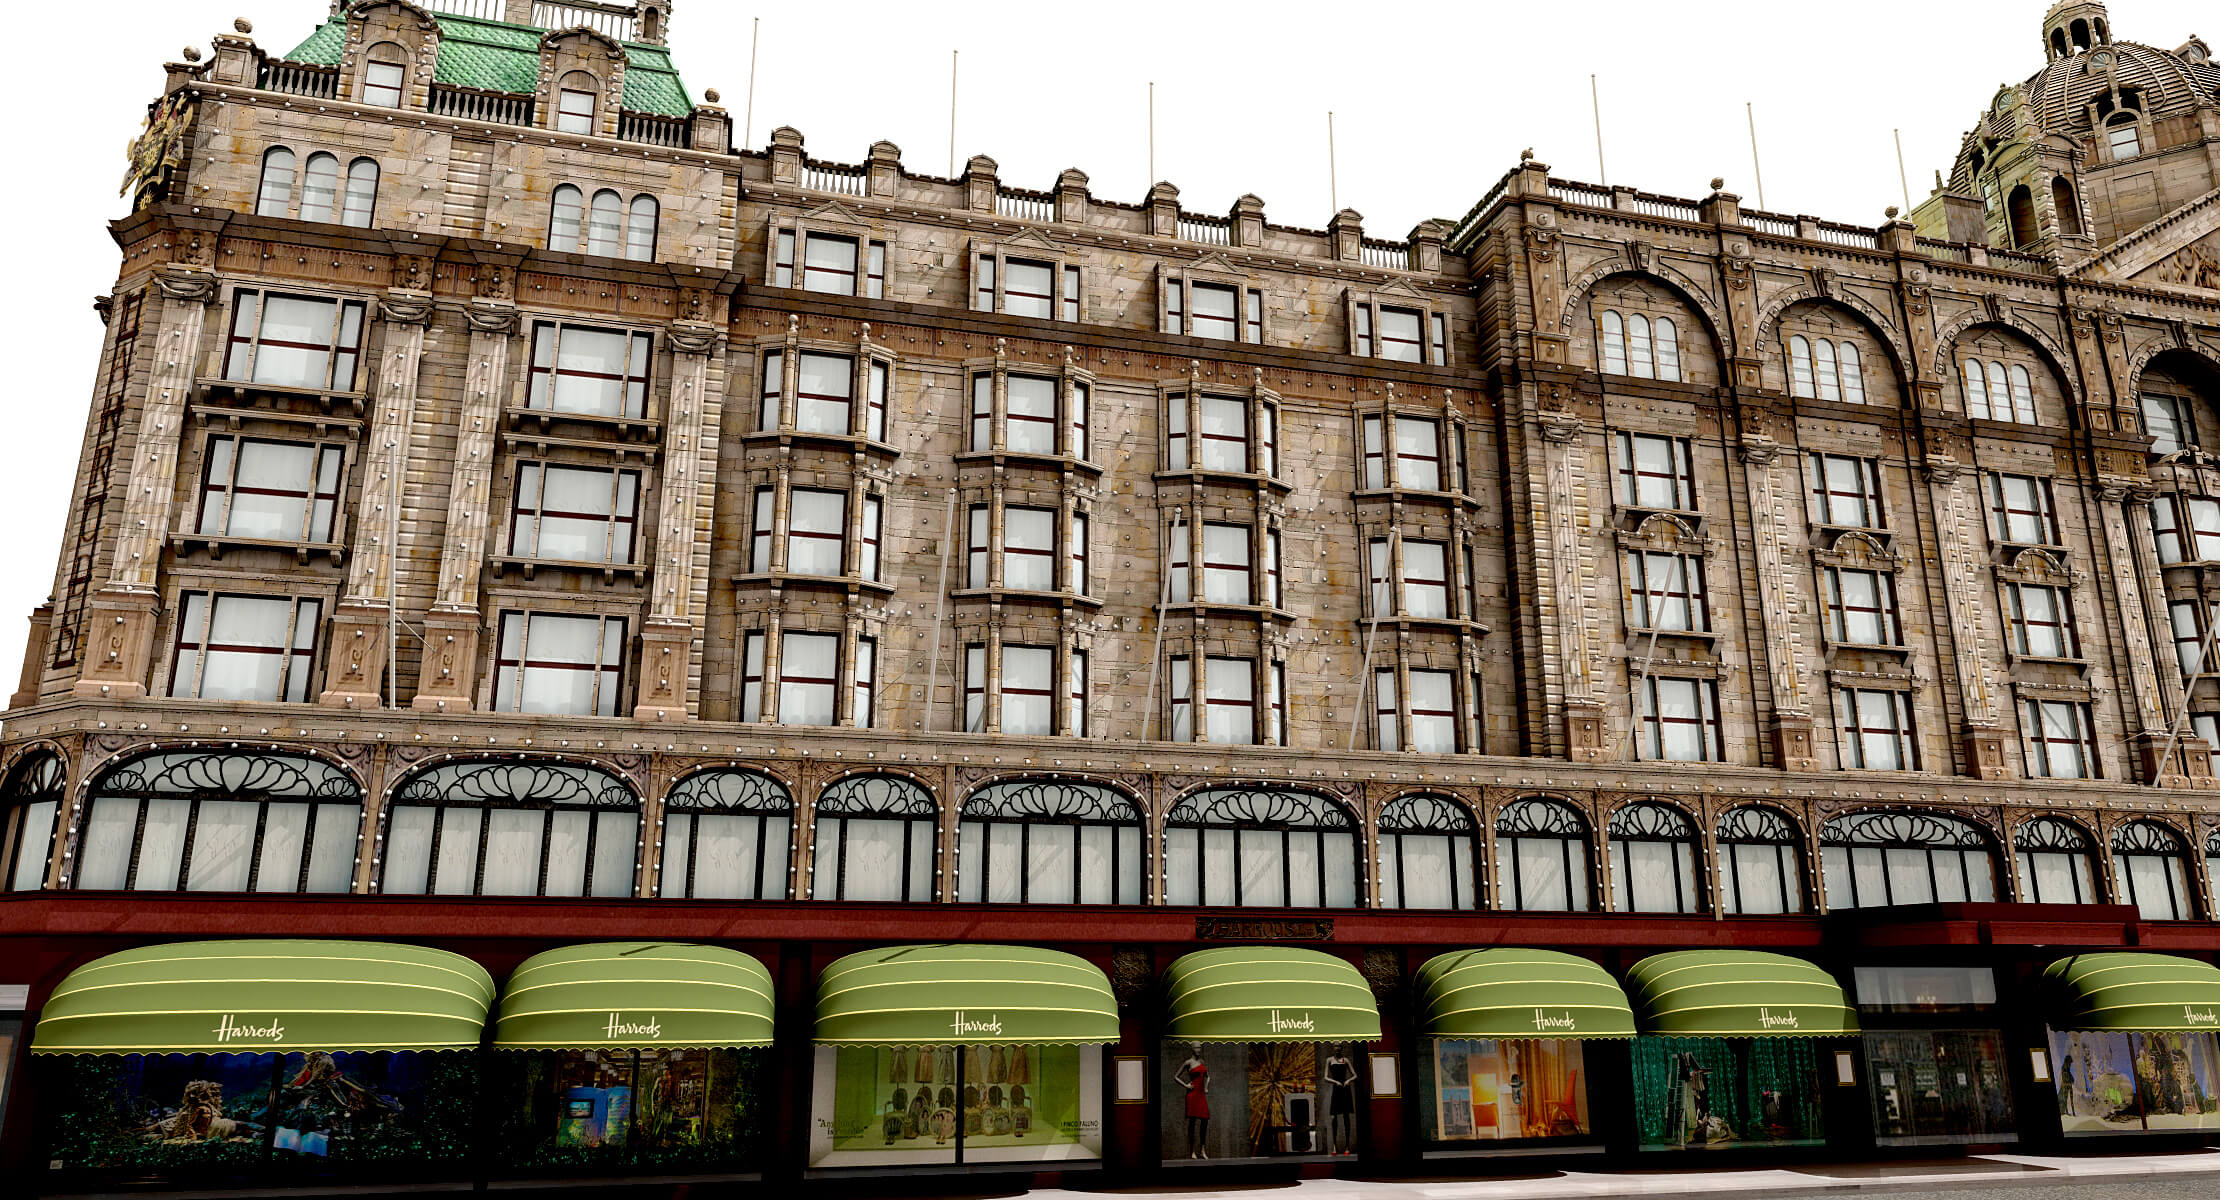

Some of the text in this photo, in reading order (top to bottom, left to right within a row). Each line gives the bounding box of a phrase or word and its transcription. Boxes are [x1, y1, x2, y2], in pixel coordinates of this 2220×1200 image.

[602, 1013, 661, 1038] Harrods
[950, 1011, 1001, 1035] Harrods
[1267, 1010, 1314, 1032] Harrods
[1532, 1009, 1575, 1030] Harrods
[1759, 1008, 1798, 1028] Harrods
[2184, 1006, 2218, 1024] Harrods
[212, 1015, 284, 1041] Harrods
